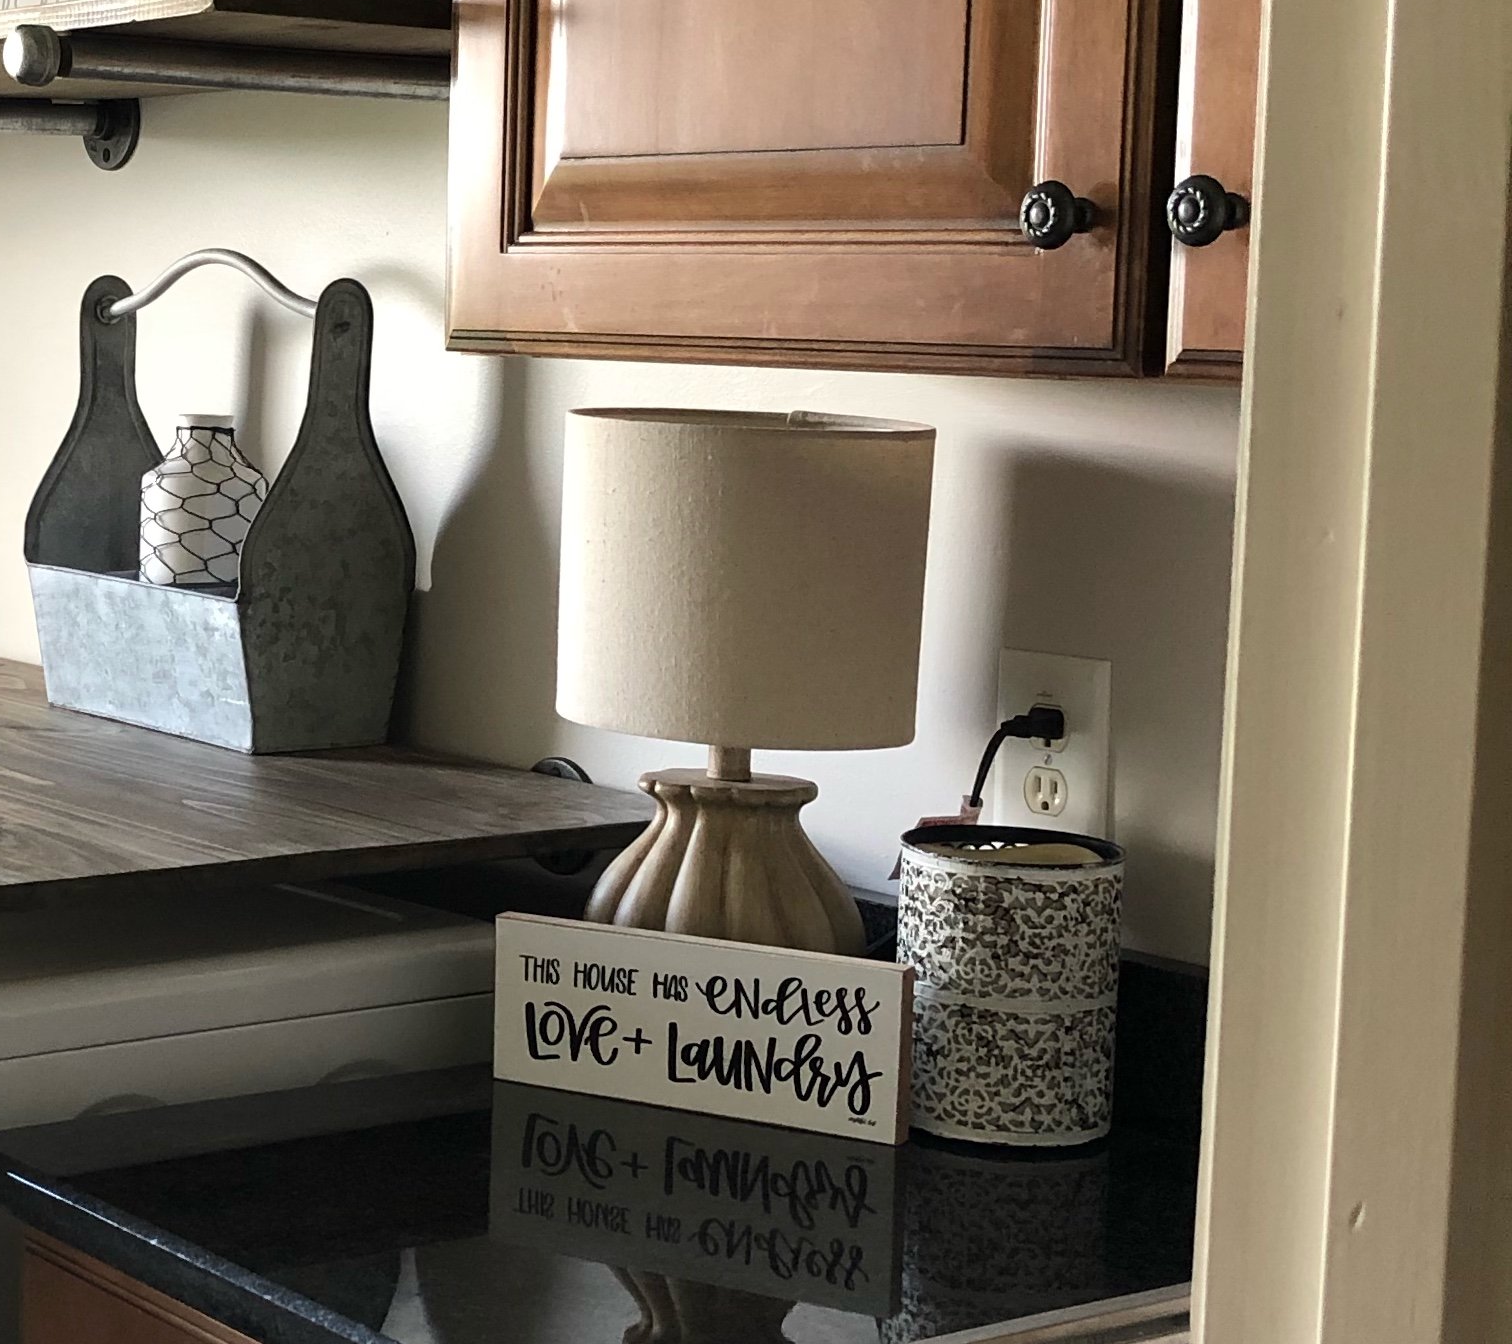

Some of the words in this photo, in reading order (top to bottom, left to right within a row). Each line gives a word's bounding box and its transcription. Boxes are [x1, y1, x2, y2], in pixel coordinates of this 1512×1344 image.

[519, 955, 561, 985] THIS
[573, 961, 639, 997] HOUSE
[652, 971, 688, 1003] HAS
